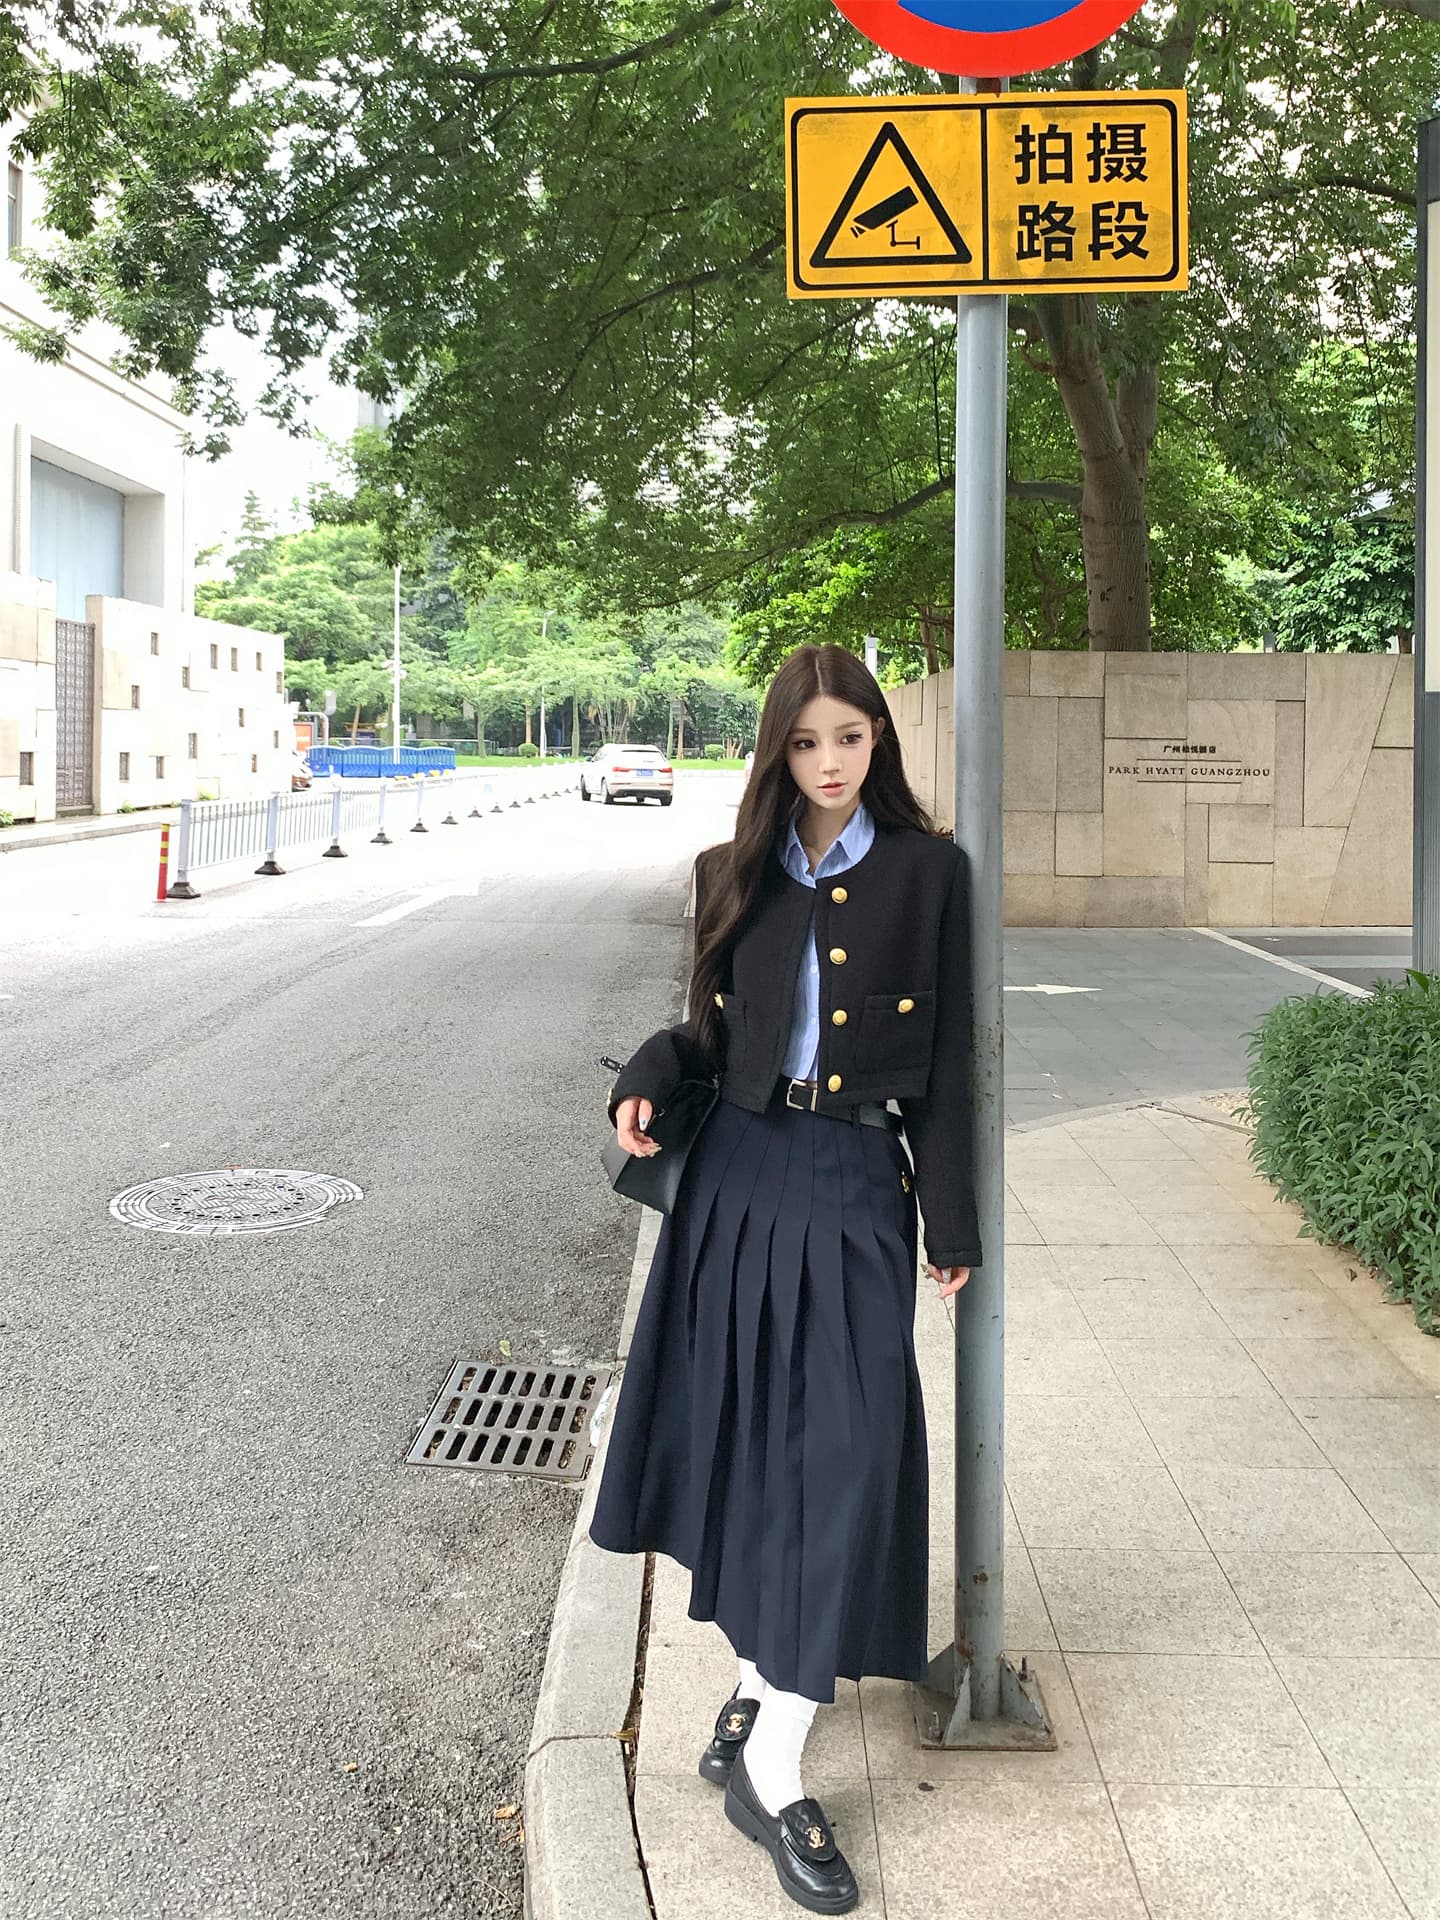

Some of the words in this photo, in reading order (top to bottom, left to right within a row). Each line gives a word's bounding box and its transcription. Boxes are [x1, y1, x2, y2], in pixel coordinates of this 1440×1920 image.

[1014, 123, 1148, 185] 拍摄
[1016, 201, 1149, 262] 路段
[1108, 766, 1140, 775] PARK
[1146, 767, 1185, 775] HYATT
[1191, 768, 1271, 777] GUANGZHOU
